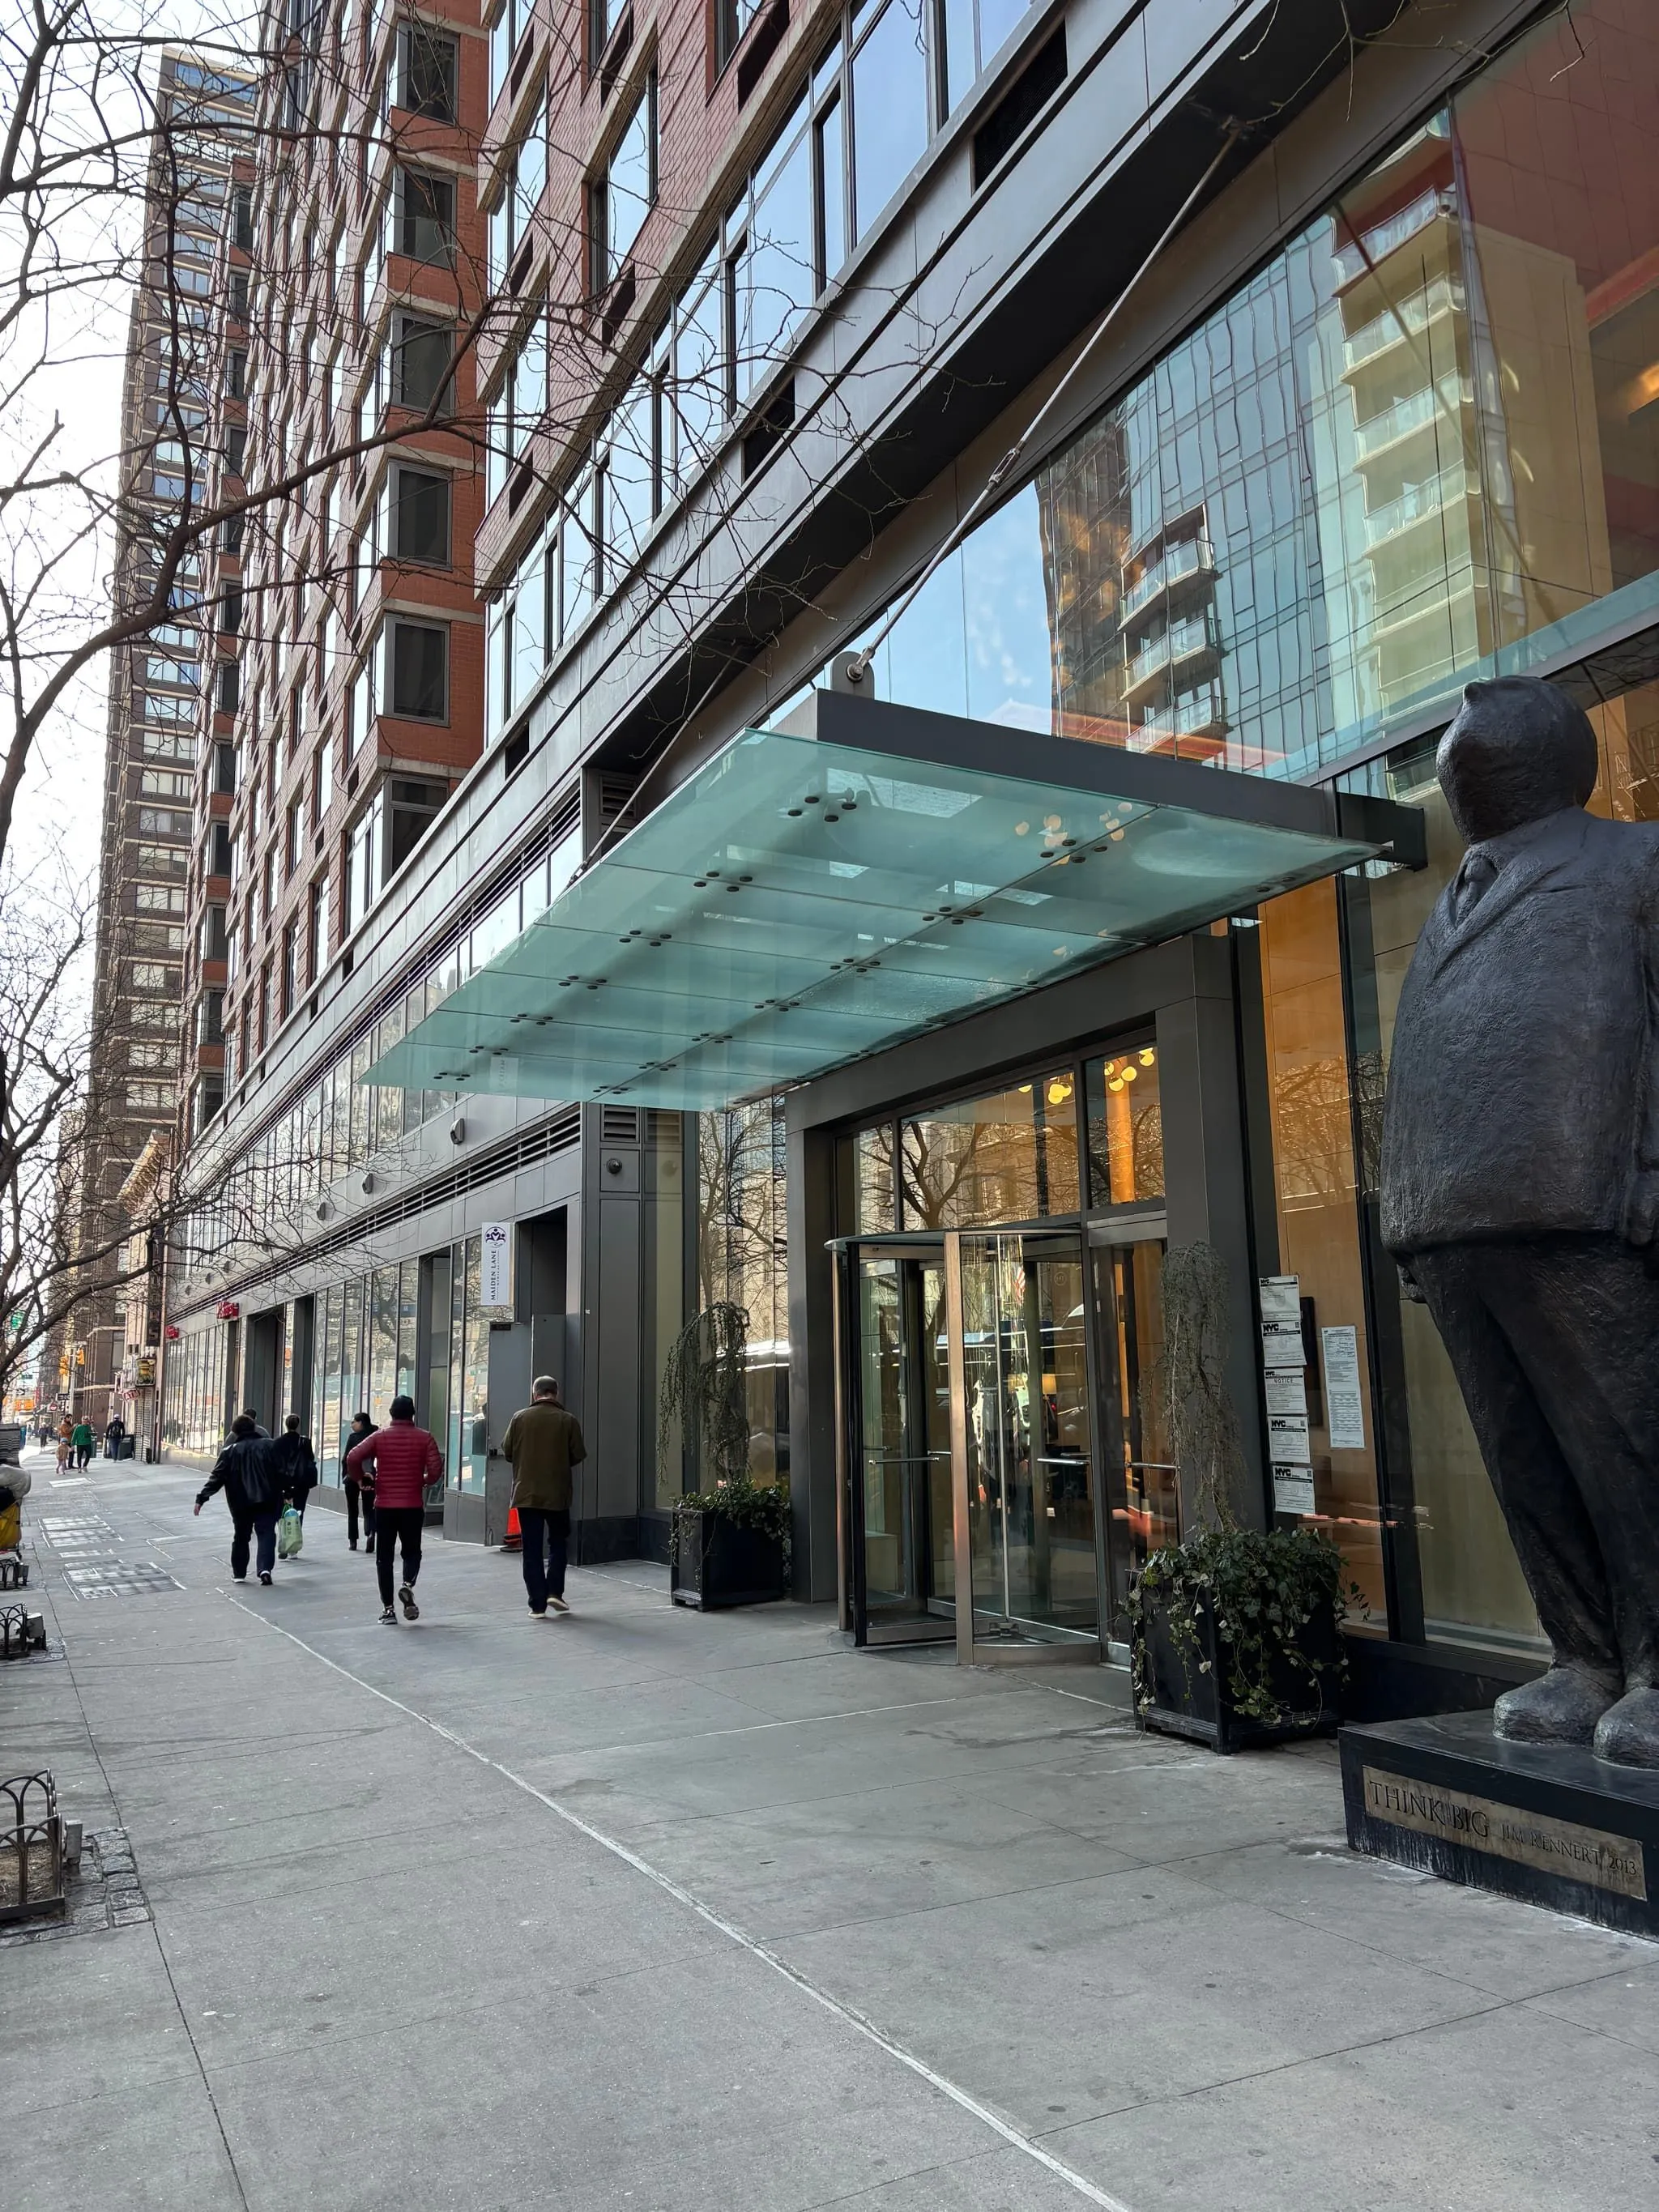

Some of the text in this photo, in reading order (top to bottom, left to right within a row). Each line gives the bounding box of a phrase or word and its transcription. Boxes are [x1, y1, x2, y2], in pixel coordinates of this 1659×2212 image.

[1263, 1323, 1279, 1332] NYC
[1275, 1467, 1291, 1477] NYC
[1369, 1780, 1637, 1875] THINK BIG JIM RENNERT 2013
